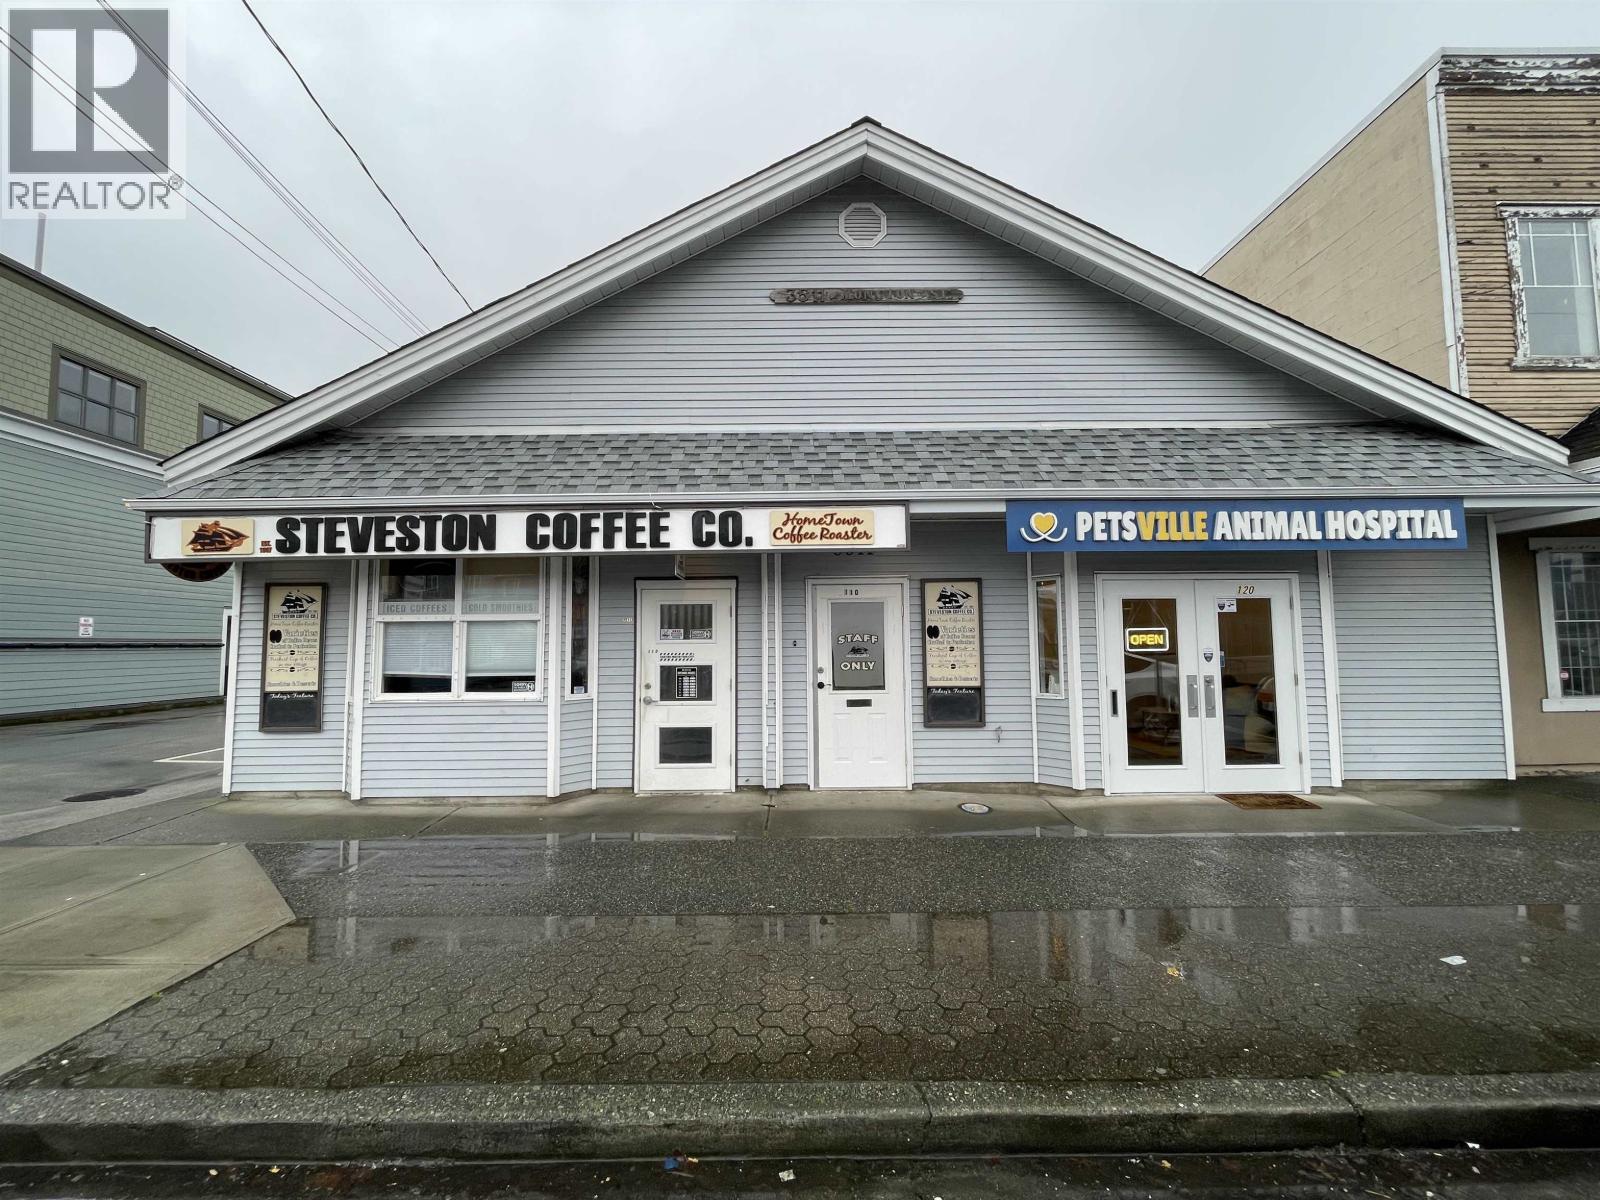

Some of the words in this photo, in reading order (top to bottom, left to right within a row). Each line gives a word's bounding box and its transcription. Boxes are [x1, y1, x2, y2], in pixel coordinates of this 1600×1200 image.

[782, 512, 864, 527] HomeTown
[1075, 511, 1209, 542] PETSVILLE
[1212, 510, 1322, 541] ANIMAL
[1324, 509, 1458, 541] HOSPITAL
[275, 514, 497, 554] STEVESTON
[525, 511, 671, 550] COFFEE
[691, 509, 753, 548] CO.
[773, 526, 819, 544] Coffee
[820, 526, 872, 541] Roaster
[1237, 585, 1255, 595] 120
[386, 603, 406, 613] ICED
[410, 603, 447, 613] COFFEES
[837, 633, 879, 644] STAFF
[1129, 634, 1164, 646] OPEN
[840, 661, 875, 671] ONLY
